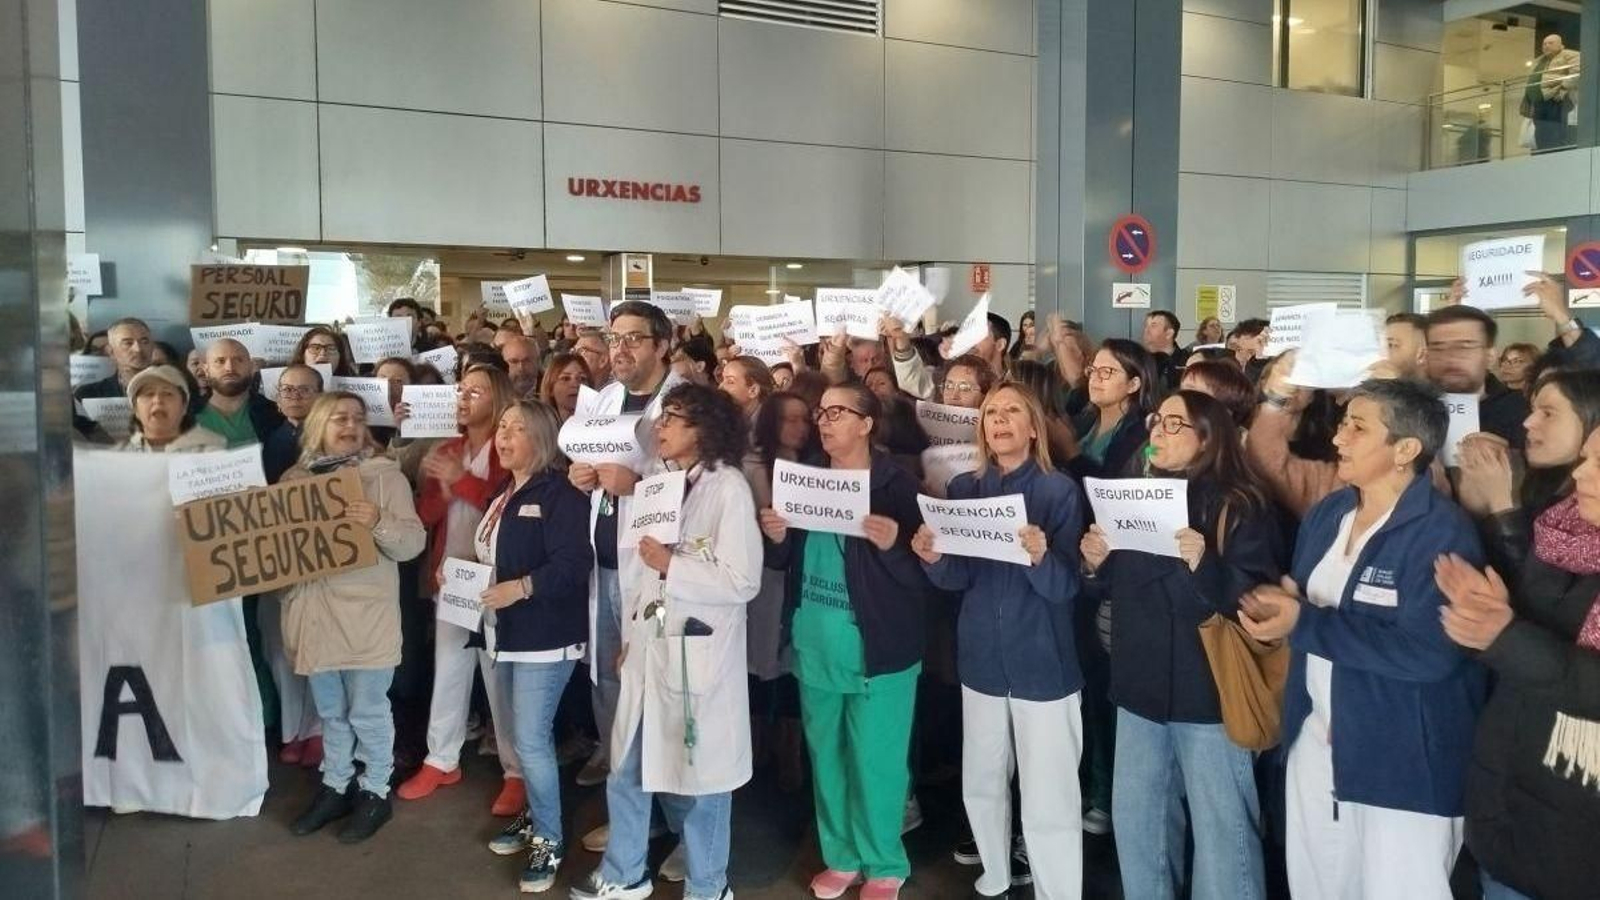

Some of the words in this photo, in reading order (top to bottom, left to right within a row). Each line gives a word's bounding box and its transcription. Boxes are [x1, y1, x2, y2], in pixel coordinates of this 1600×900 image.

[568, 177, 702, 203] URXENCIAS
[201, 266, 292, 286] PERSOAL
[202, 290, 302, 320] SEGURO
[820, 294, 874, 304] URXENCIAS
[824, 313, 868, 323] SEGURAS
[199, 329, 253, 339] SEGURIDADE
[425, 354, 442, 363] STOP
[743, 348, 784, 358] SEGURAS
[585, 418, 616, 427] STOP
[920, 408, 978, 426] URXENCIAS
[565, 441, 634, 454] AGRESIÓNS
[645, 482, 665, 498] STOP
[780, 471, 861, 492] URXENCIAS
[1093, 487, 1174, 501] SEGURIDADE
[183, 477, 349, 542] URXENCIAS
[785, 501, 854, 521] SEGURAS
[925, 503, 1016, 519] URXENCIAS
[631, 510, 677, 530] AGRESIÓNS
[1115, 519, 1158, 533] XA!!!!!
[940, 526, 1014, 544] SEGURAS
[211, 523, 359, 594] SEGURAS
[455, 568, 476, 581] STOP
[810, 575, 846, 594] EXCLUSI
[94, 665, 185, 763] A
